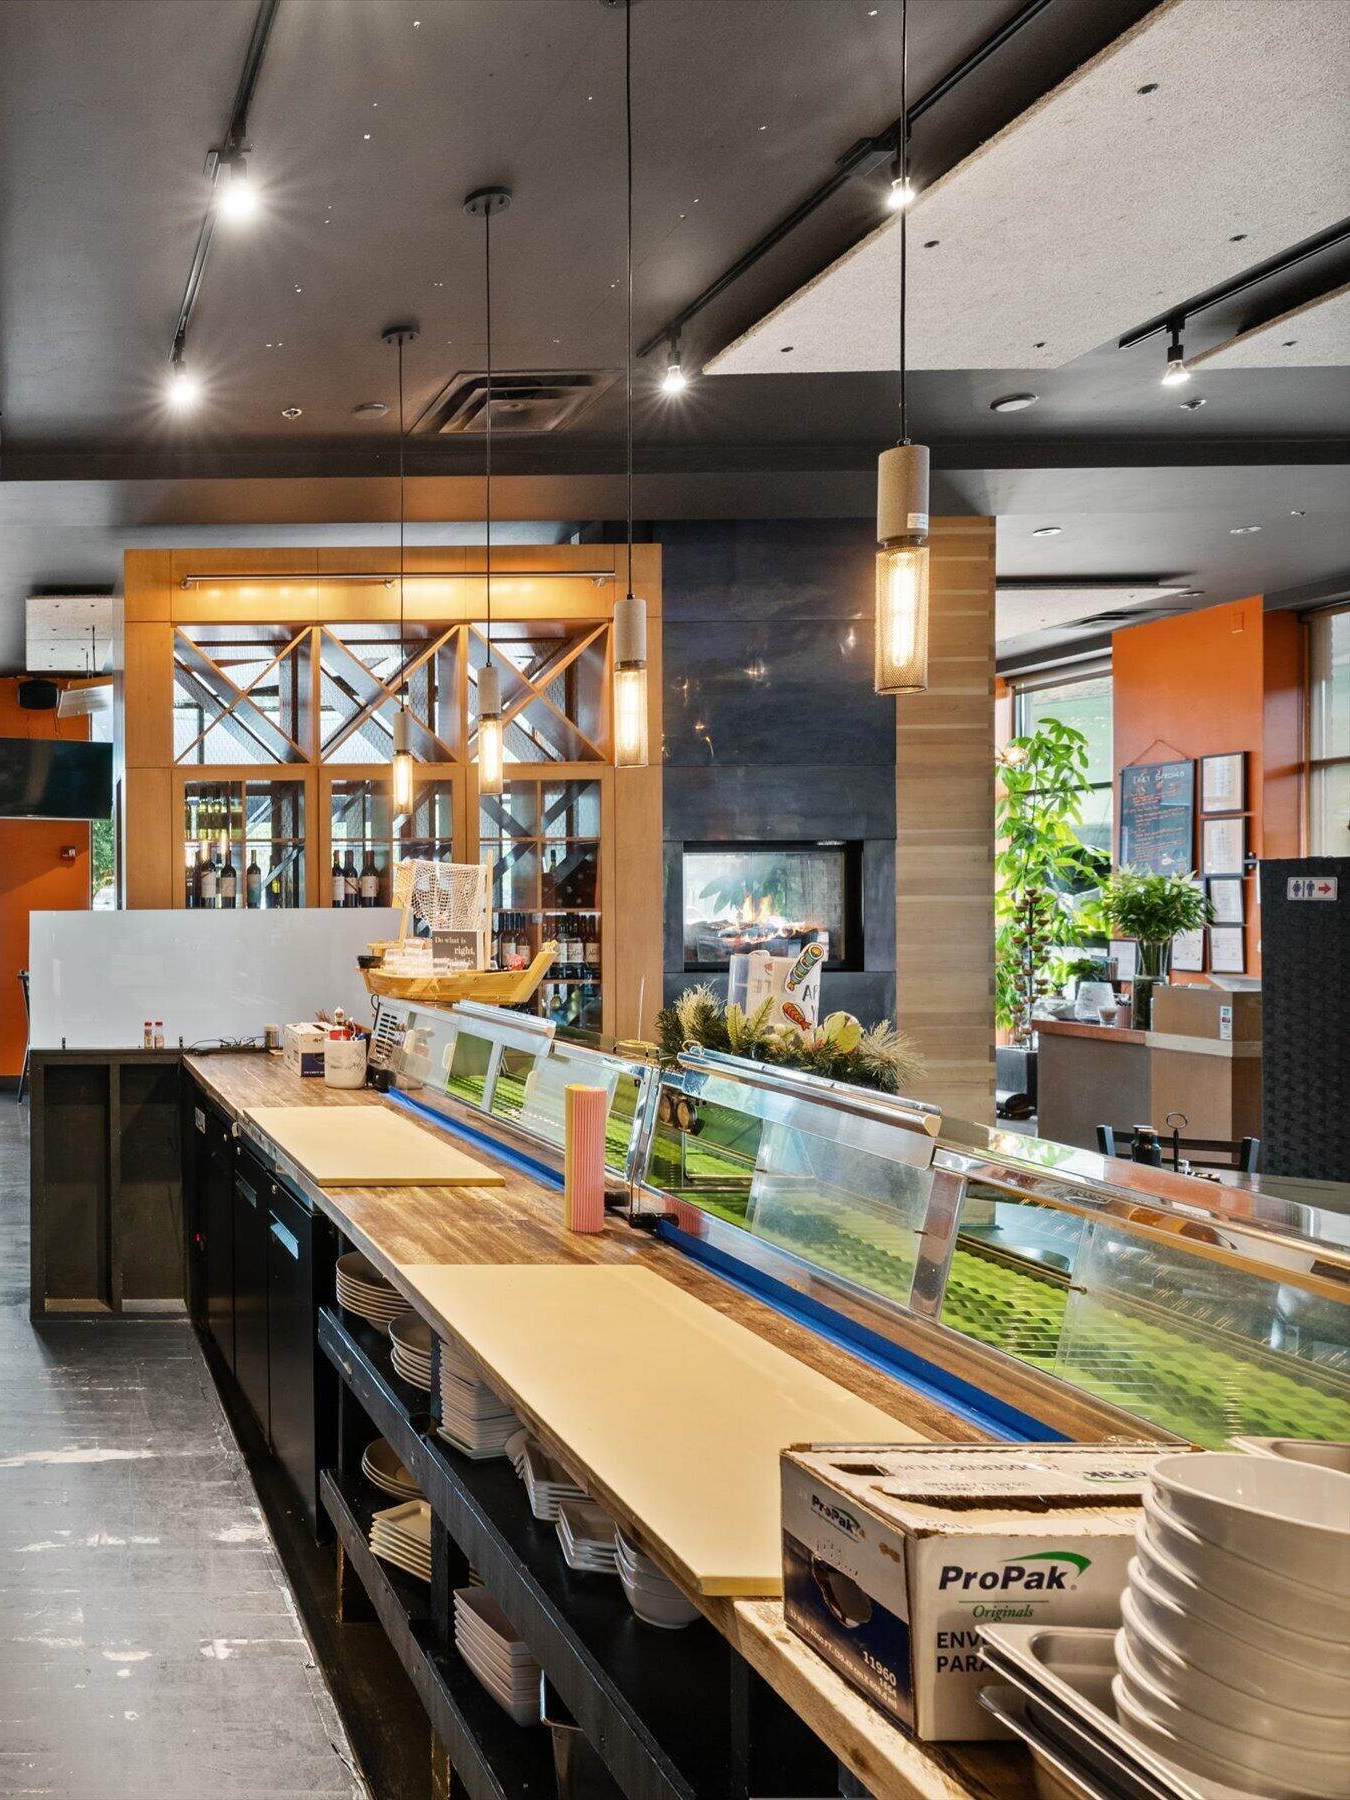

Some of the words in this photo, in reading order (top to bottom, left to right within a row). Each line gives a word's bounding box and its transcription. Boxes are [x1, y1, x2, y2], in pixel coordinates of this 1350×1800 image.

[435, 936, 444, 944] Do
[445, 936, 459, 944] what
[454, 945, 476, 956] right,
[811, 1494, 856, 1537] ProPak
[938, 1566, 1068, 1590] ProPak
[972, 1604, 1034, 1623] Originals
[862, 1650, 898, 1687] 11960
